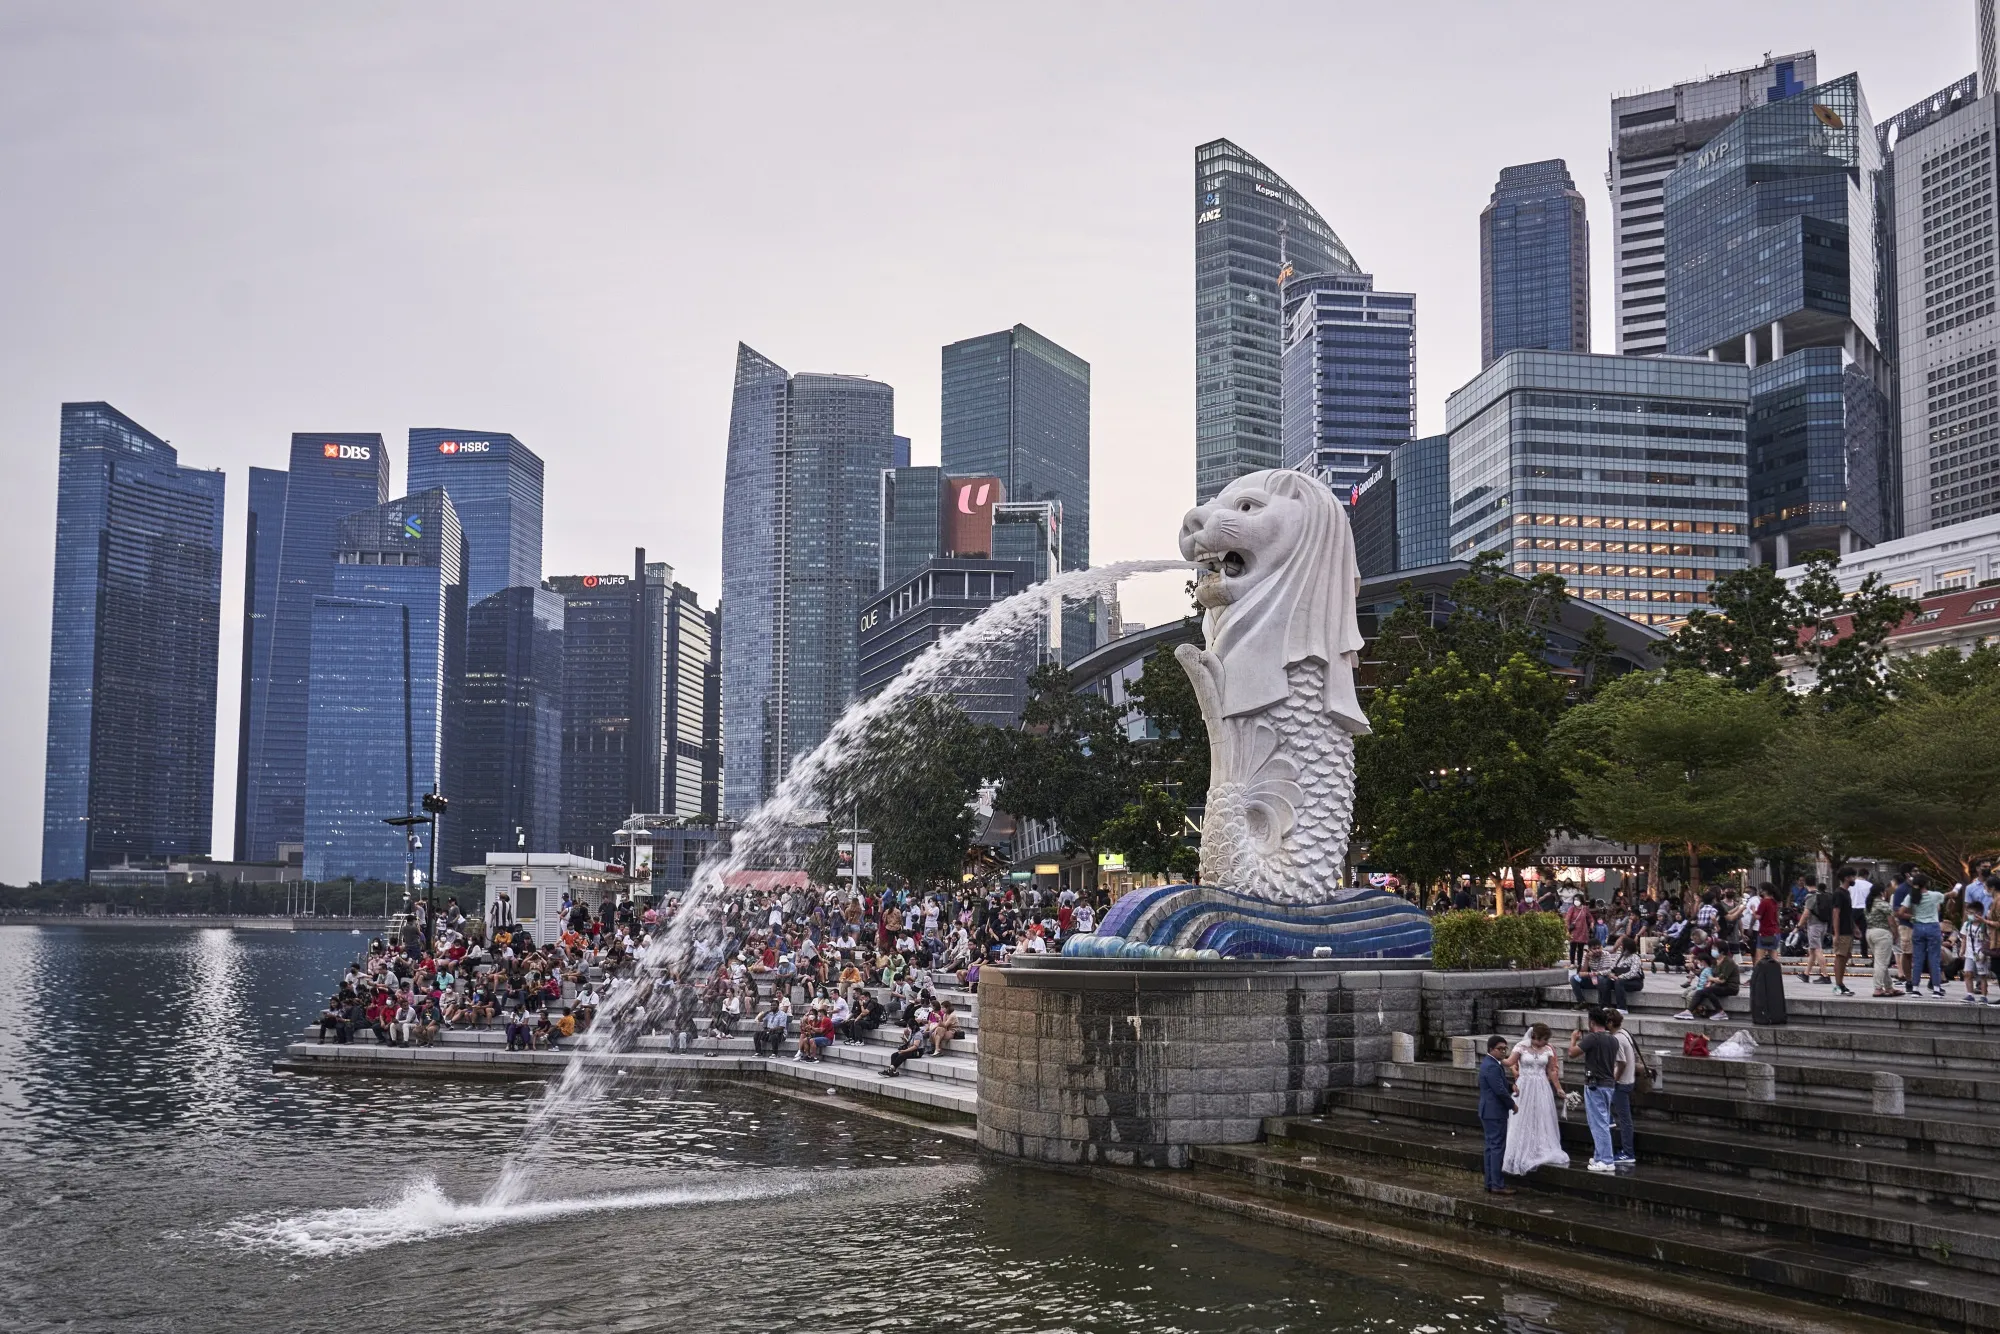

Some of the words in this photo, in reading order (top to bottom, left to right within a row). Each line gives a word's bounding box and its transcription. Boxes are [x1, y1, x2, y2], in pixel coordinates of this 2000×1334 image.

[1809, 133, 1847, 147] MYP
[1698, 142, 1729, 170] MYP
[1255, 184, 1282, 199] Keppel
[1198, 208, 1222, 225] ANZ
[339, 445, 371, 460] DBS
[459, 442, 490, 453] HSBC
[598, 577, 625, 585] MUFG
[860, 609, 878, 632] OUE
[1540, 855, 1580, 865] COFFEE
[1595, 855, 1638, 865] GELATO
